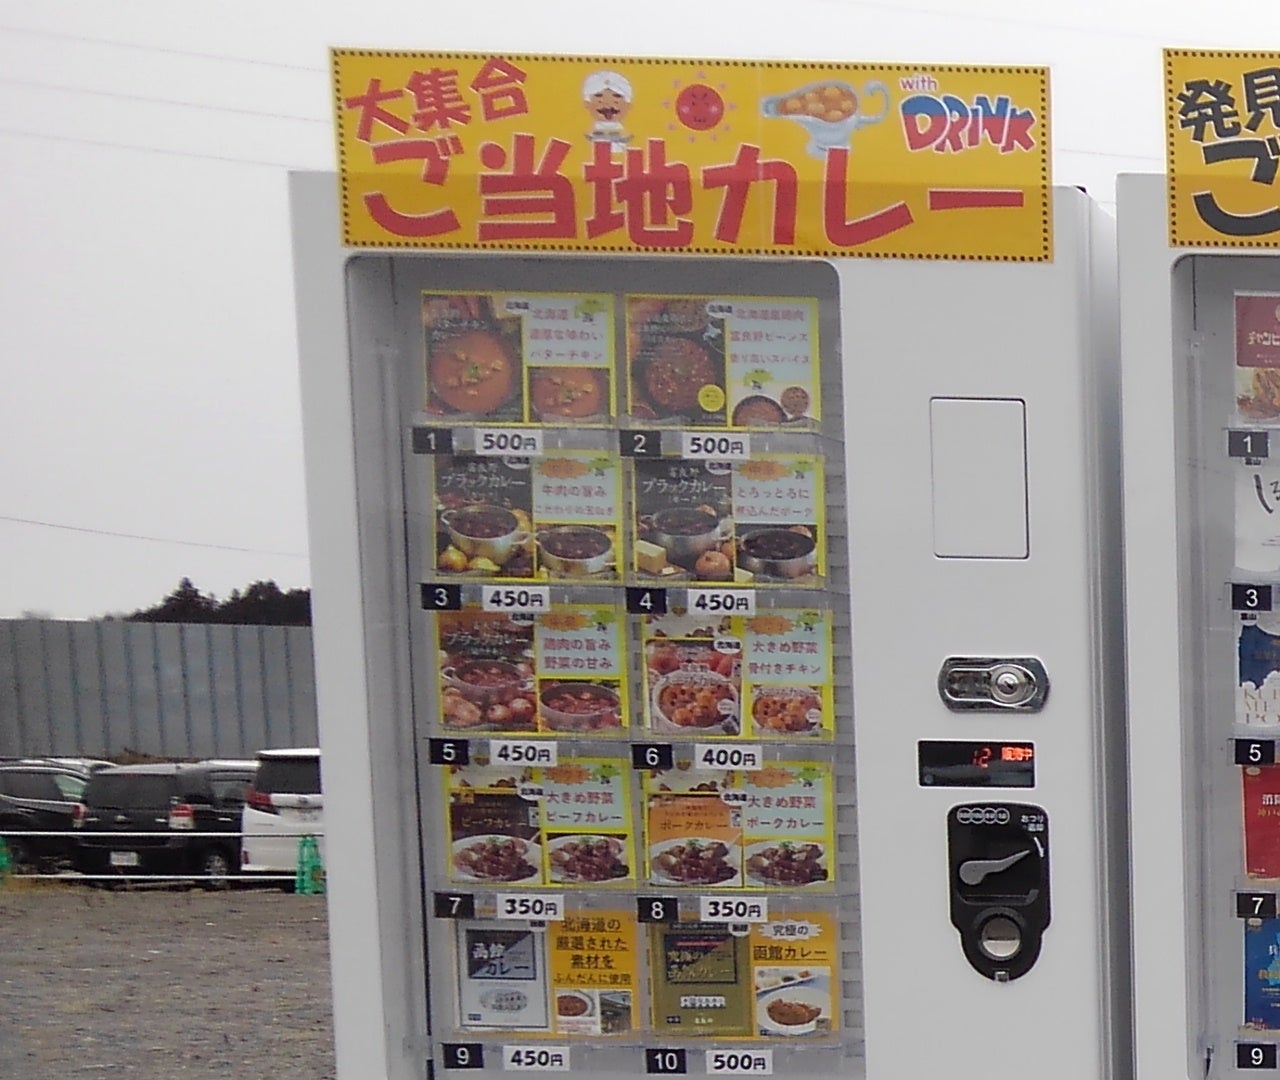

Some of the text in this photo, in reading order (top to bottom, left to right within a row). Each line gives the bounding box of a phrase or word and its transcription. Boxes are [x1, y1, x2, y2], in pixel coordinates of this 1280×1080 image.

[901, 75, 938, 91] with
[346, 56, 528, 142] 大集合
[364, 135, 1024, 246] ご当地カレー
[483, 434, 536, 450] 500円
[690, 437, 743, 454] 500円
[490, 591, 543, 607] 450円
[695, 594, 749, 611] 450円
[497, 745, 550, 762] 450円
[702, 749, 755, 766] 400円
[505, 899, 557, 915] 350円
[709, 901, 761, 917] 350円
[511, 1050, 563, 1066] 450円
[714, 1054, 766, 1070] 500円
